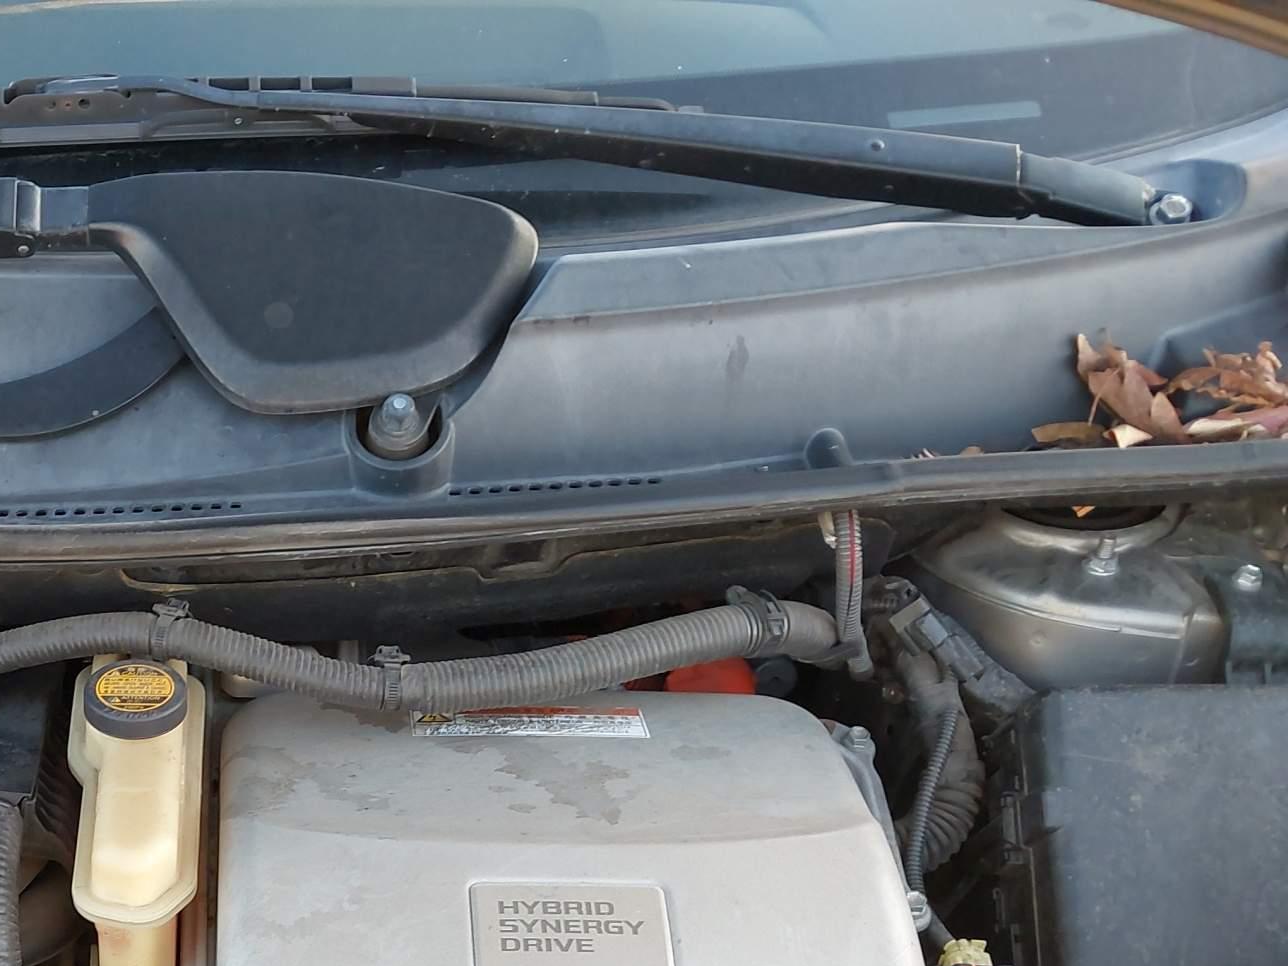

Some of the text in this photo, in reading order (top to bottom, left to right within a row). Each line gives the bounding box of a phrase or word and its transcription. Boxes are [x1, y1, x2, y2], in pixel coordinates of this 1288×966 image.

[498, 900, 614, 916] HYBRID
[499, 919, 644, 935] SYNERGY
[500, 938, 594, 952] DRIVE
